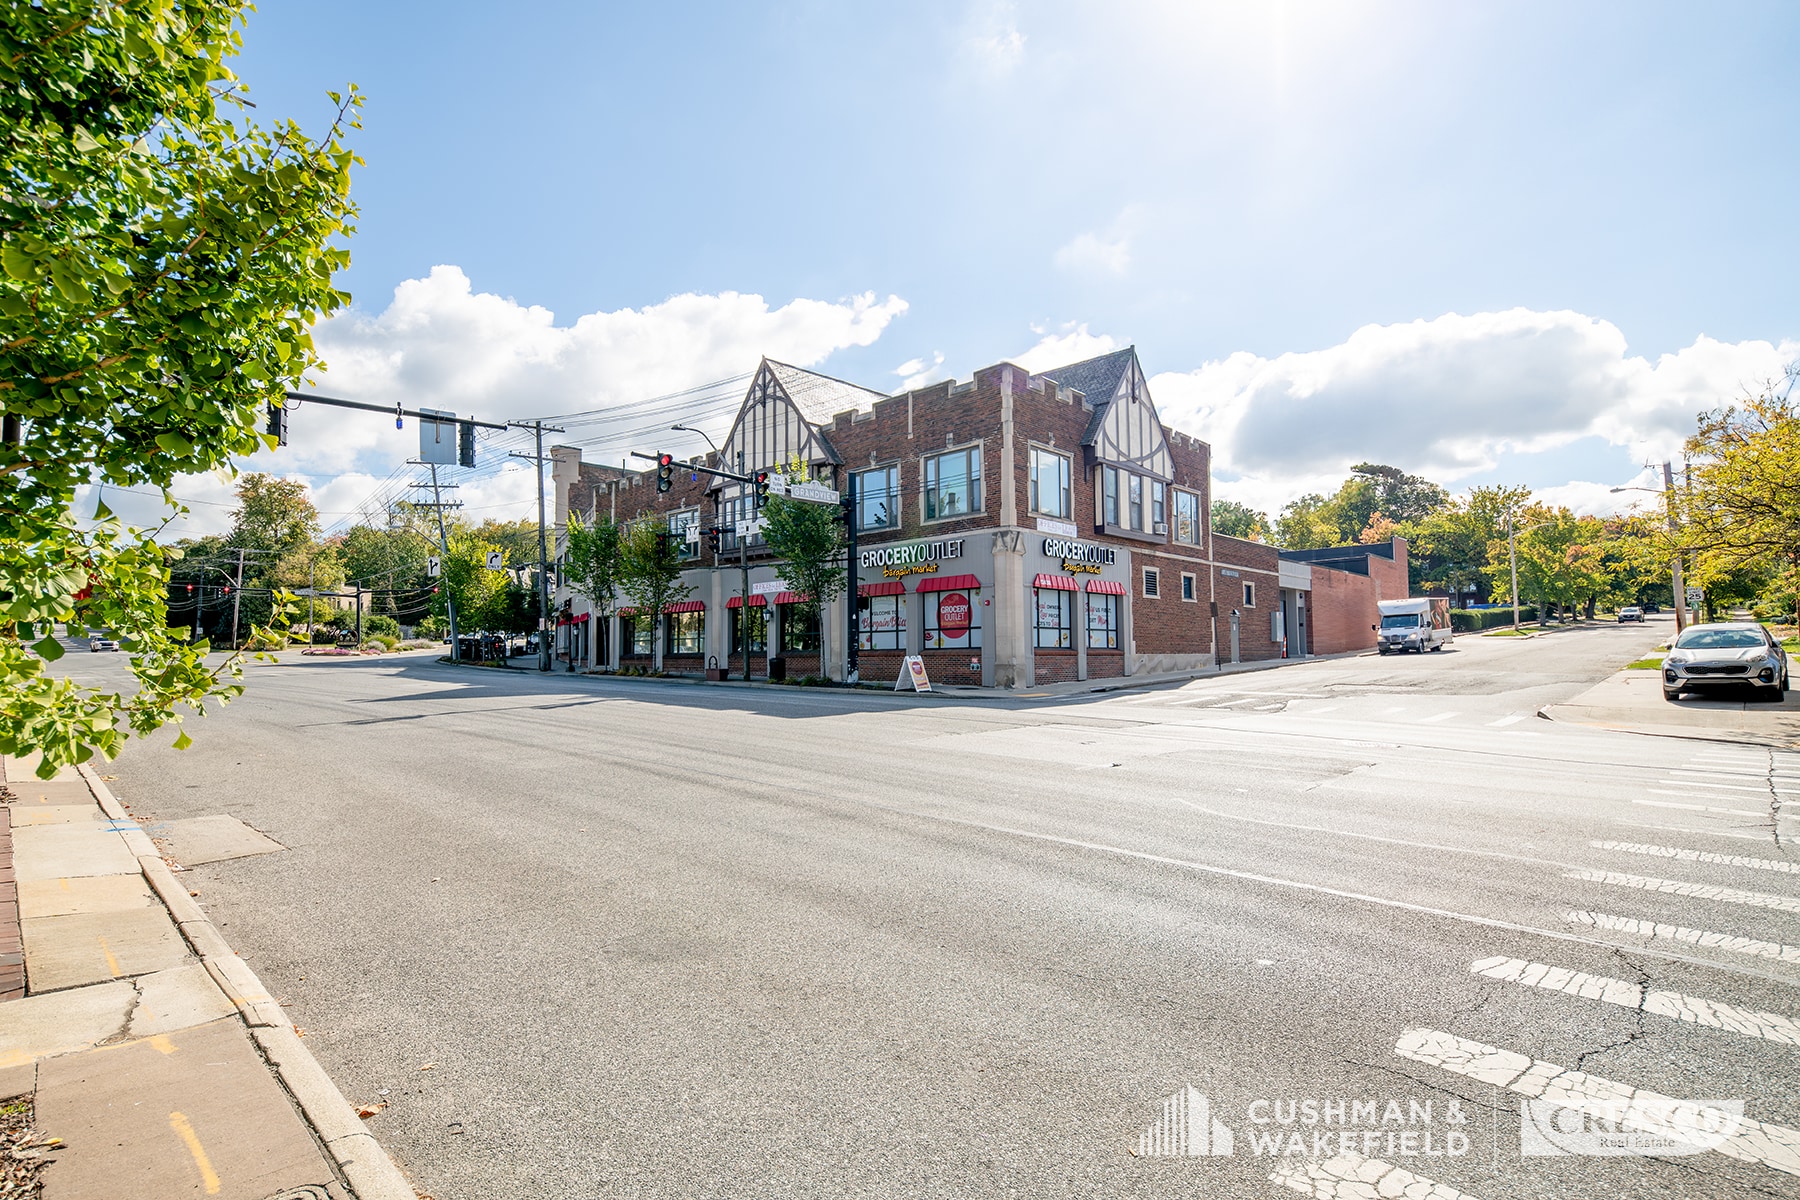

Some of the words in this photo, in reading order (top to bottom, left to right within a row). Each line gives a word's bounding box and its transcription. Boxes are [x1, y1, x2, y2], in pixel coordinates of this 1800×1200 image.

[794, 487, 837, 501] GRANDVIEW
[883, 565, 912, 580] bargain
[912, 562, 938, 574] market
[940, 604, 968, 614] GROCERY
[944, 613, 965, 621] OUTLET
